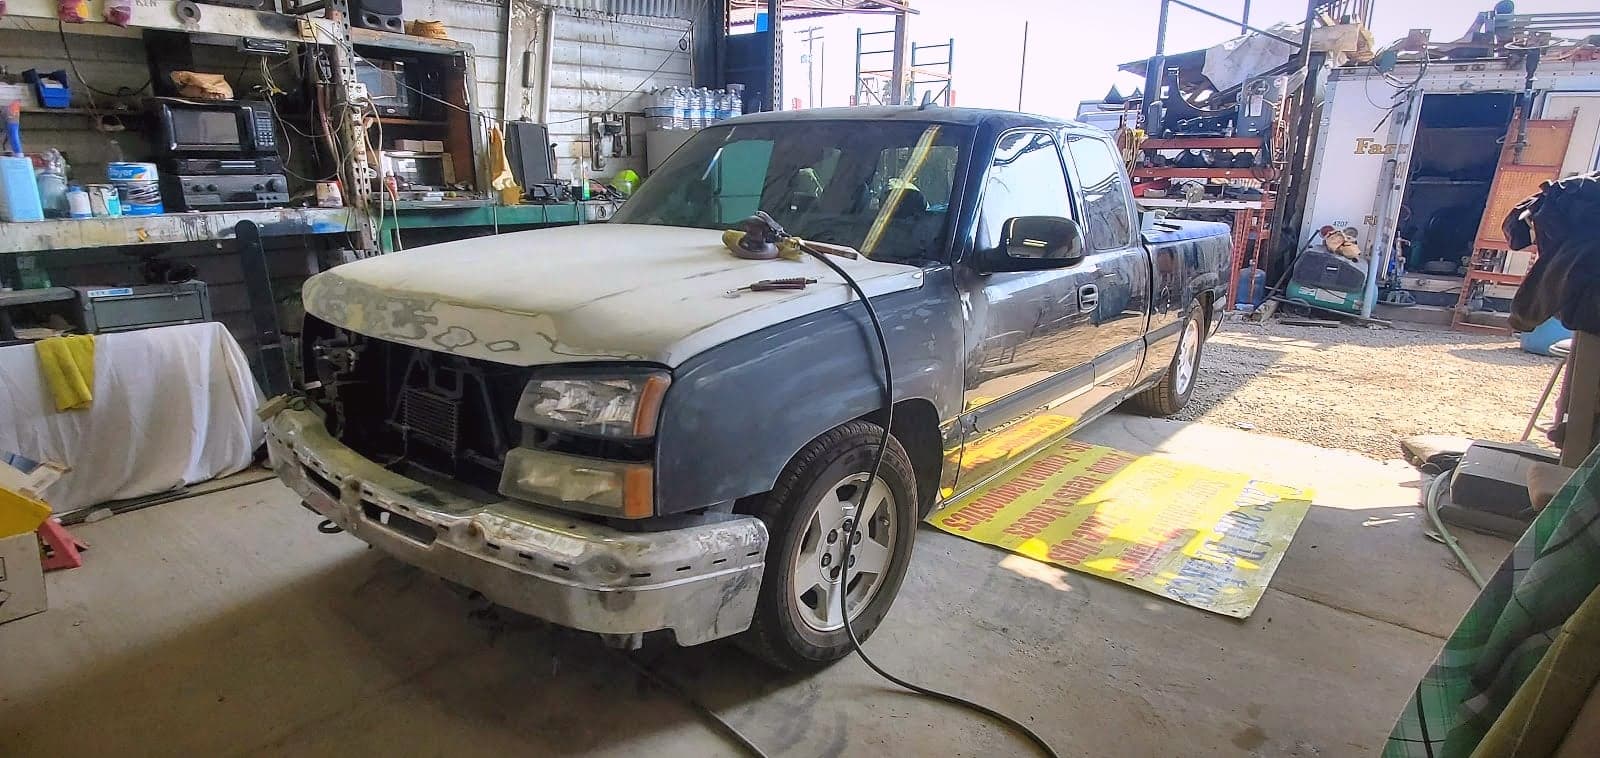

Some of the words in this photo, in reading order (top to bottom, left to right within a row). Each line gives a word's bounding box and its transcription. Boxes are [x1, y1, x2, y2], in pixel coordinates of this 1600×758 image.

[1022, 455, 1074, 481] Engine
[1057, 476, 1103, 500] Belts
[941, 478, 1041, 532] Diagnostics
[1043, 497, 1072, 508] &
[1004, 506, 1068, 538] Hoses
[1046, 539, 1101, 565] Ups
